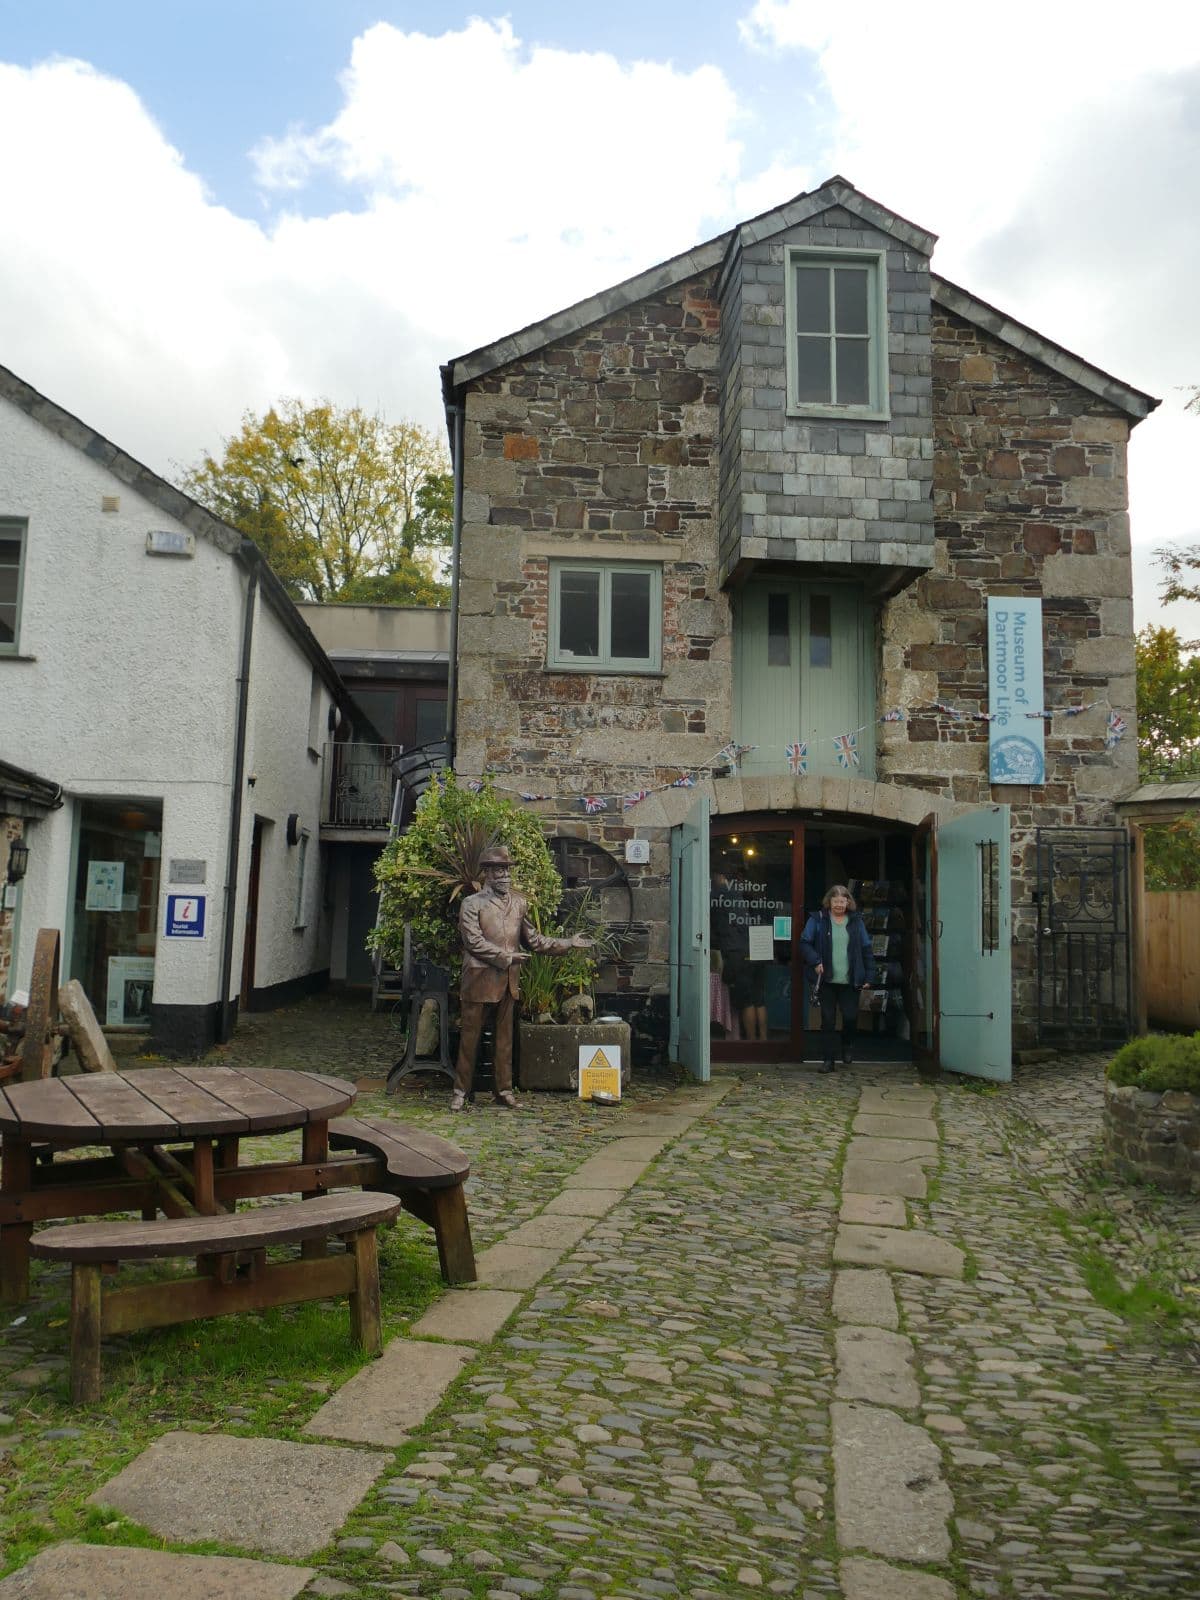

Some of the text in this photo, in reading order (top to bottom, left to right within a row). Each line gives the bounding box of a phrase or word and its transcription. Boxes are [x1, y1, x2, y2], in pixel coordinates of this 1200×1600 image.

[1013, 612, 1029, 705] Museum of
[995, 611, 1011, 727] Dartmoor Life
[724, 879, 767, 892] Visitor
[711, 894, 784, 910] nformation
[728, 912, 762, 925] Point
